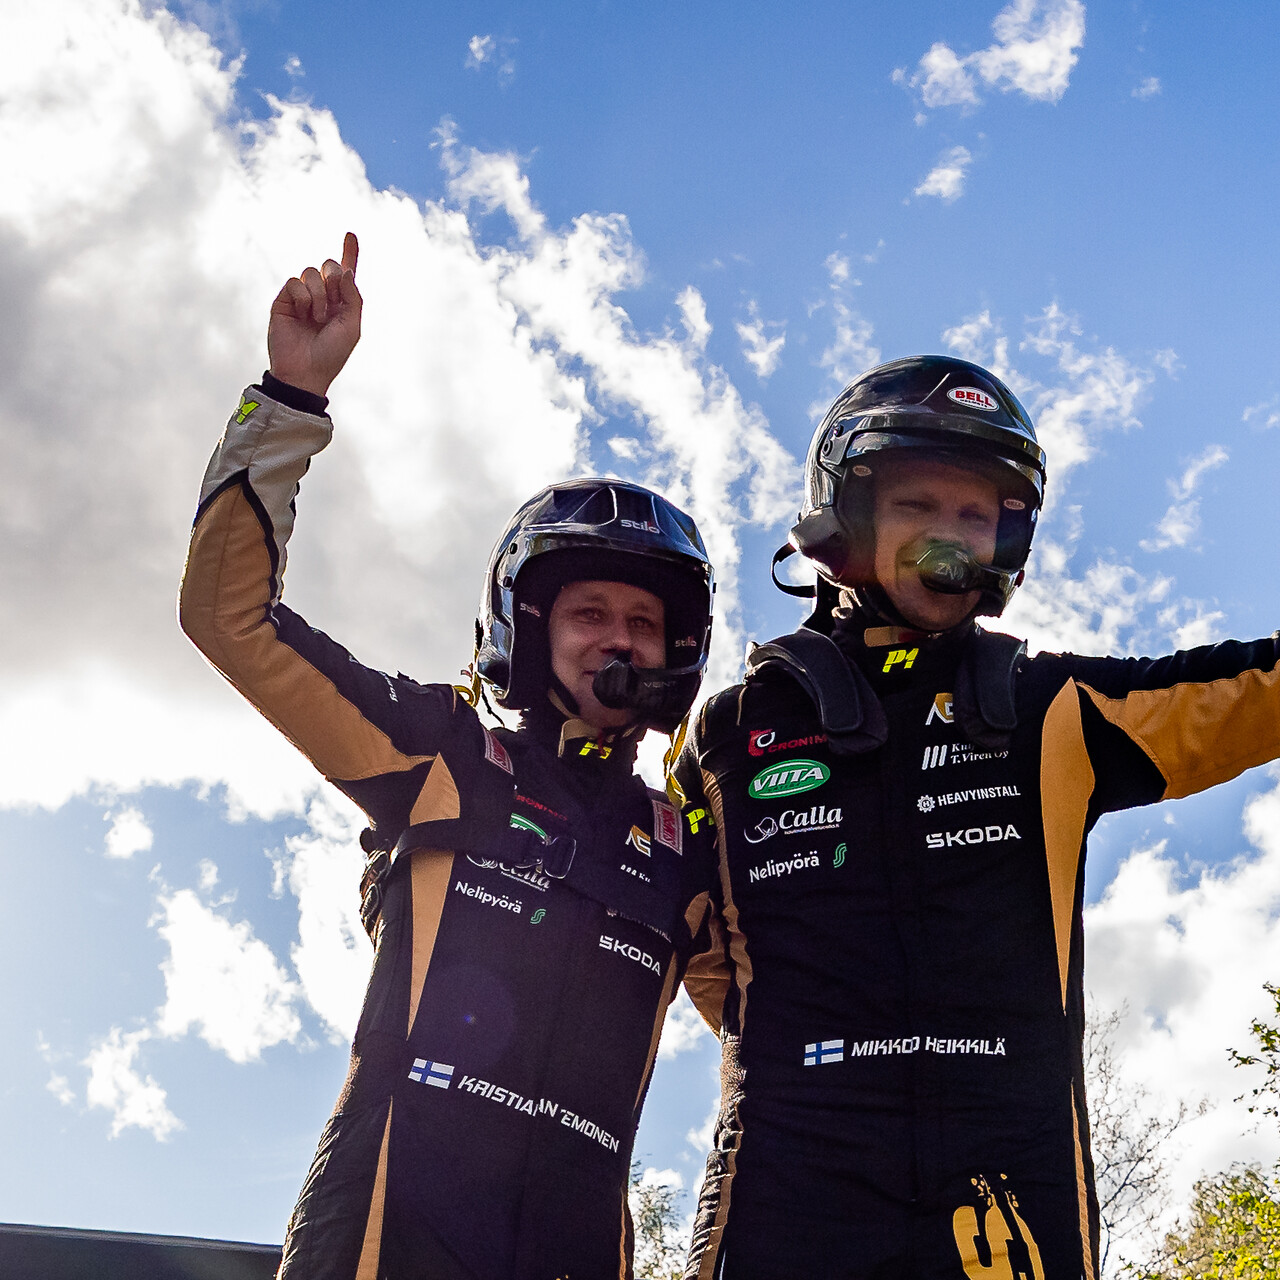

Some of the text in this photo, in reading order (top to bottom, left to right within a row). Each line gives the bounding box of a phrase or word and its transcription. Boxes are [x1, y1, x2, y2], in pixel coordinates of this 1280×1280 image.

[955, 390, 994, 408] BELL
[768, 734, 828, 753] CRONIM
[753, 767, 824, 792] VIITA
[938, 785, 1021, 806] HEAVYINSTALL
[779, 805, 844, 830] Calla
[749, 850, 820, 883] Nelipyörä
[455, 881, 523, 914] Nelipyörä
[851, 1036, 1007, 1056] MIKKO HEIKKILÄ
[560, 1108, 620, 1154] EMONEN
